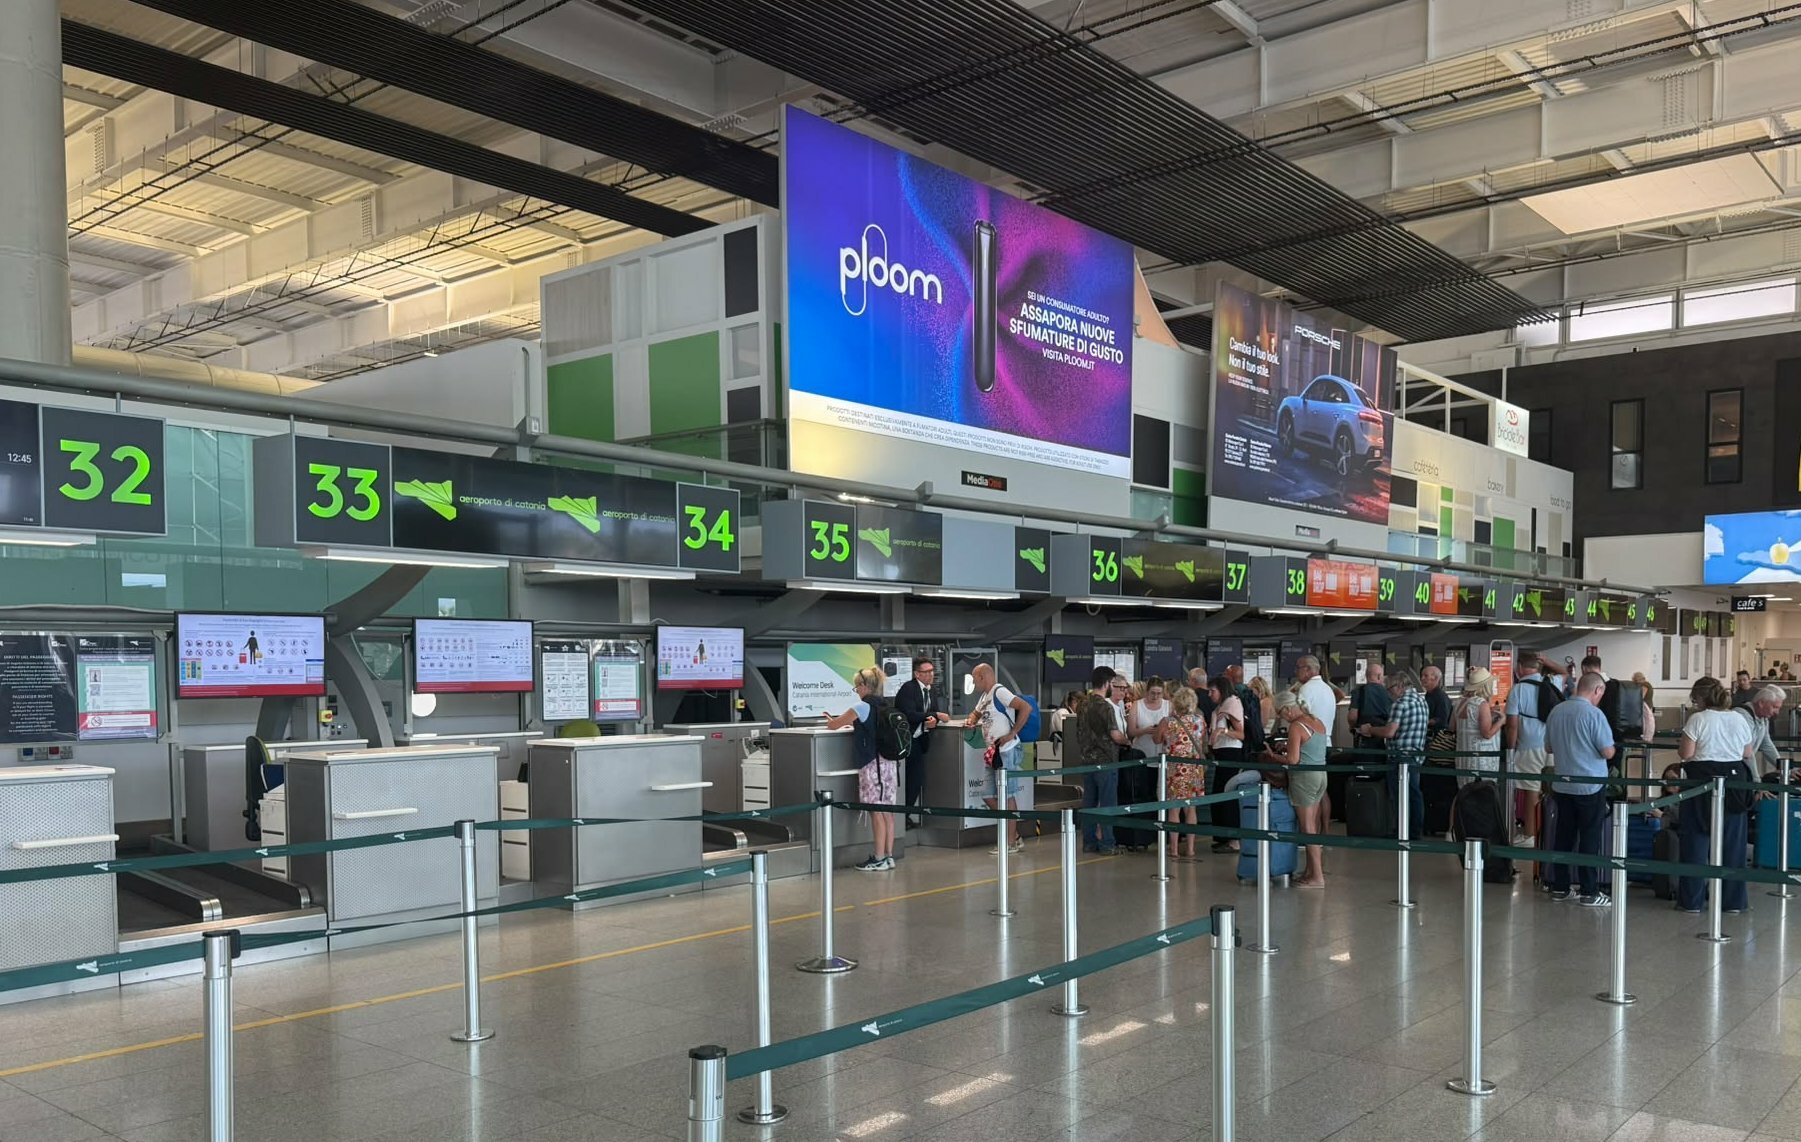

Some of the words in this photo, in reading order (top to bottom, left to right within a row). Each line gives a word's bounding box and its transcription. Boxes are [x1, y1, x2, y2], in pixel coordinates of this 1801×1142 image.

[840, 224, 942, 316] ploom
[1028, 290, 1036, 300] SEI
[1037, 294, 1045, 304] UN
[1046, 297, 1086, 317] CONSUMATORE
[1087, 310, 1110, 324] ADULTO?
[1020, 302, 1078, 334] ASSAPORA
[1080, 320, 1115, 344] NUOVE
[1010, 318, 1075, 350] SFUMATURE
[1077, 338, 1088, 354] DI
[1089, 342, 1124, 364] GUSTO
[1294, 325, 1340, 350] PORSCHE
[1042, 347, 1063, 362] VISITA
[1064, 353, 1095, 370] PLOOM.IT
[1229, 337, 1251, 355] Cambia
[1253, 345, 1256, 357] il
[1257, 347, 1266, 360] tuo
[1267, 350, 1280, 365] look.
[1228, 354, 1241, 368] Non
[1242, 358, 1245, 370] il
[1246, 360, 1256, 374] tuo
[1257, 363, 1269, 377] stile.
[8, 453, 32, 463] 12:45
[59, 438, 152, 505] 32
[308, 462, 380, 521] 33
[460, 496, 502, 506] aeroporto
[505, 498, 512, 506] di
[515, 500, 546, 510] catania
[602, 510, 638, 520] aeroporto
[640, 512, 647, 520] di
[649, 514, 675, 523] catania
[684, 505, 734, 552] 34
[810, 520, 850, 562] 35
[1092, 550, 1118, 582] 36
[1226, 563, 1246, 590] 37
[1287, 569, 1304, 595] 38
[1379, 578, 1394, 600] 39
[1415, 582, 1430, 604] 40
[1485, 589, 1495, 610] 41
[1513, 593, 1524, 613] 42
[1565, 598, 1575, 616] 43
[1587, 600, 1597, 617] 44
[1627, 603, 1636, 620] 45
